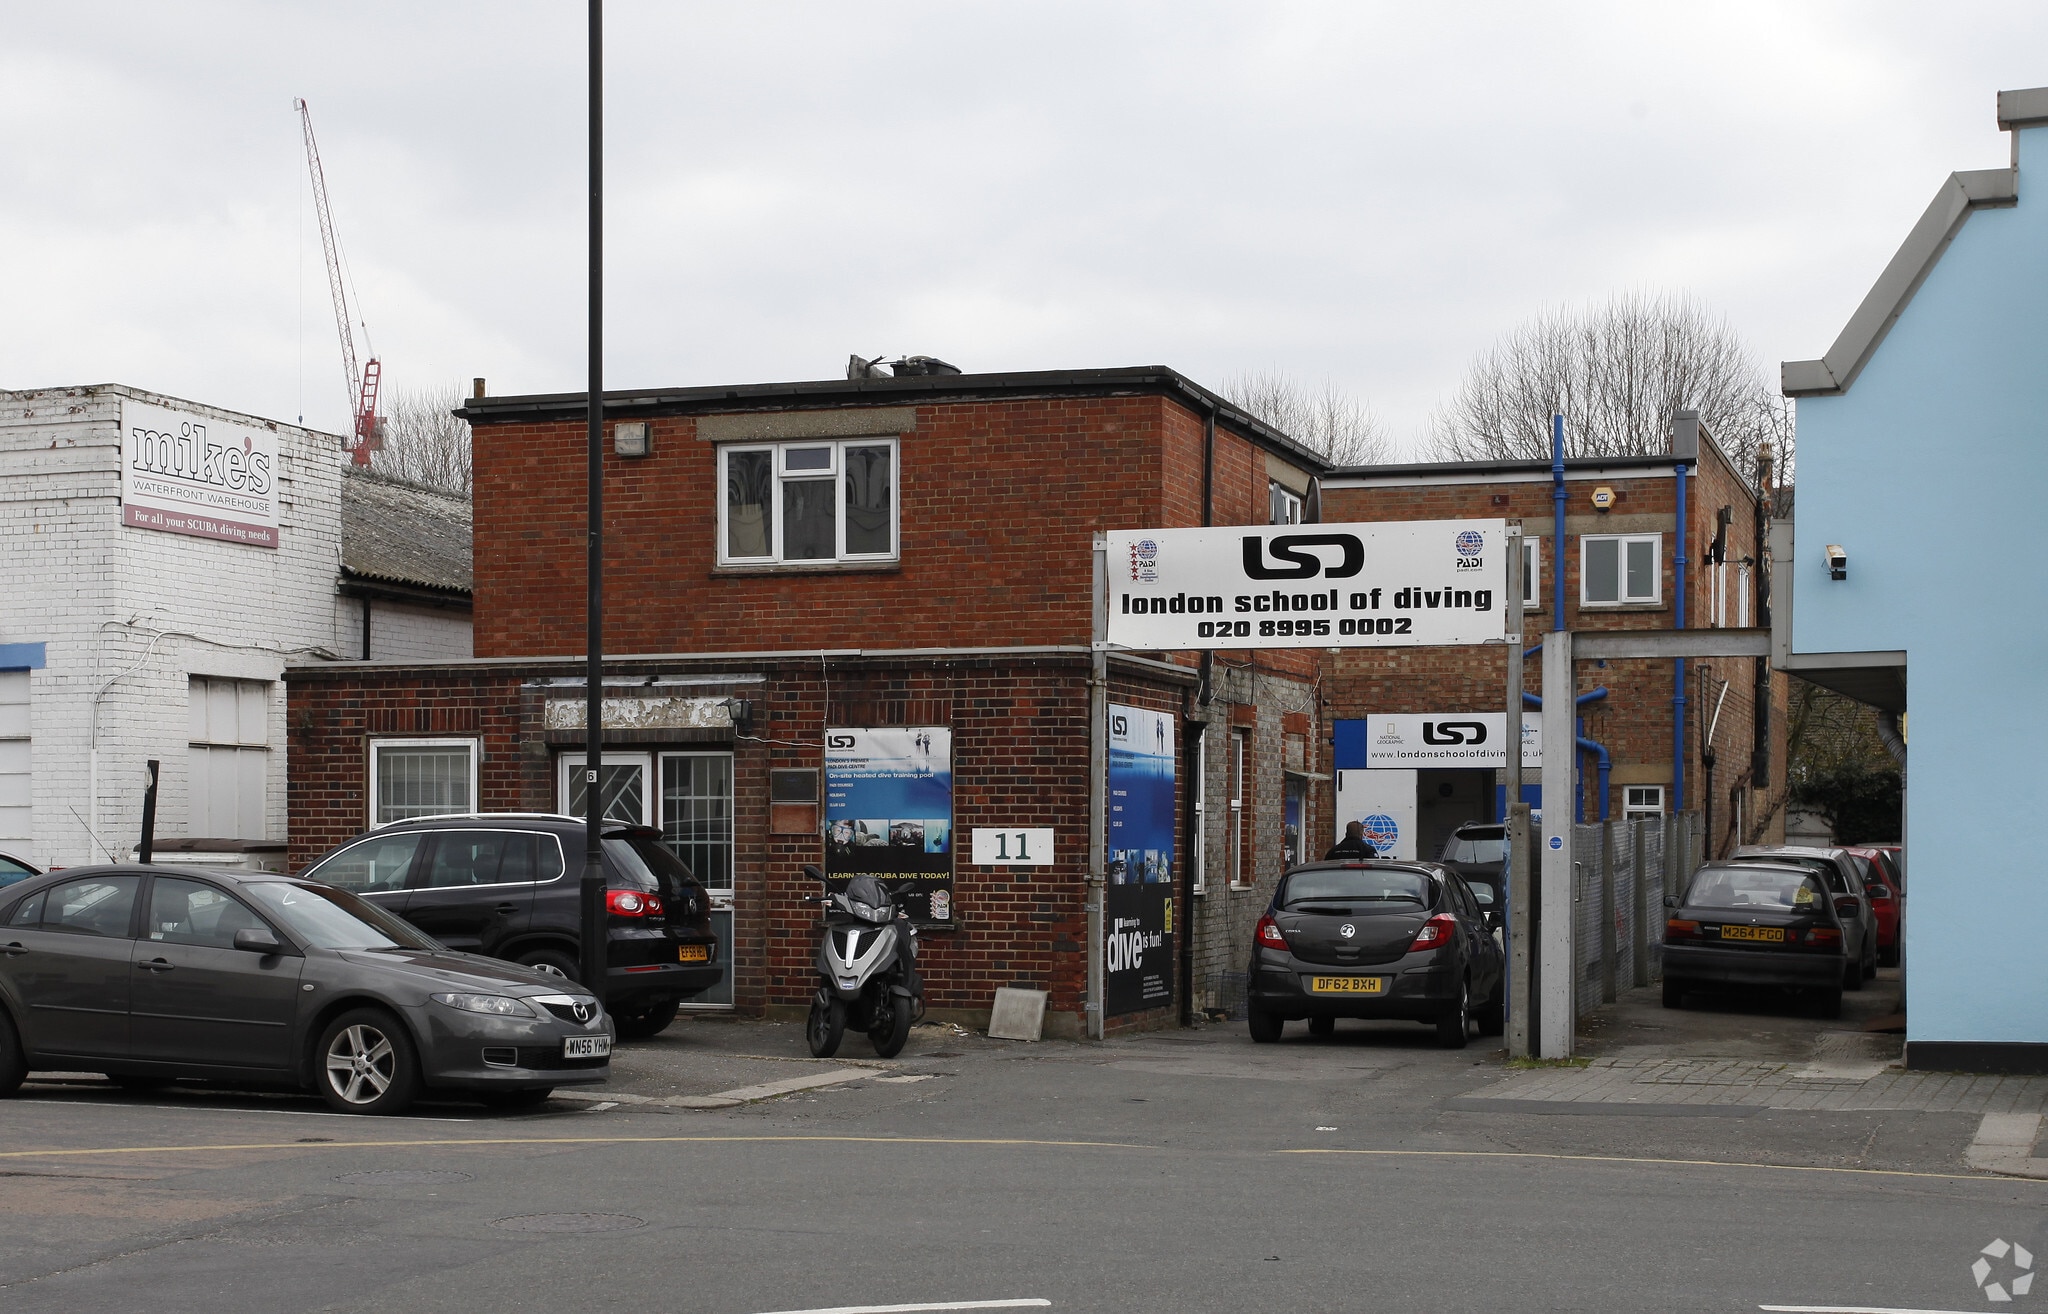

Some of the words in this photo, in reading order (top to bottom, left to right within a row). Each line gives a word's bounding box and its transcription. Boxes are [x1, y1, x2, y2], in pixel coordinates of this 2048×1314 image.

[132, 421, 271, 495] mike's
[133, 480, 204, 501] WATERFRONT
[207, 493, 270, 512] WAREHOUSE
[135, 510, 149, 522] For
[151, 513, 164, 525] all
[166, 516, 185, 528] your
[187, 519, 218, 533] SCUBA
[220, 523, 246, 540] diving
[248, 530, 271, 541] needs
[1139, 560, 1156, 568] PADI
[1243, 534, 1365, 580] LSD
[1456, 557, 1483, 568] PADI
[1122, 592, 1223, 615] london
[1234, 588, 1338, 613] school
[1350, 587, 1382, 610] of
[1394, 586, 1492, 611] diving
[1198, 620, 1250, 638] 020
[1259, 619, 1331, 637] 8995
[1339, 618, 1412, 635] 0002
[1112, 715, 1128, 736] LSD
[1422, 721, 1488, 745] LSD
[828, 735, 855, 748] LSD
[587, 771, 595, 781] 6
[995, 833, 1031, 860] 11
[919, 871, 950, 879] TODAY!
[1723, 926, 1756, 938] M264
[1758, 930, 1783, 940] FGO
[1107, 918, 1143, 973] dive
[1142, 931, 1149, 948] is
[1149, 930, 1162, 948] fun!
[1317, 978, 1349, 990] DF62
[1352, 978, 1376, 990] BXH
